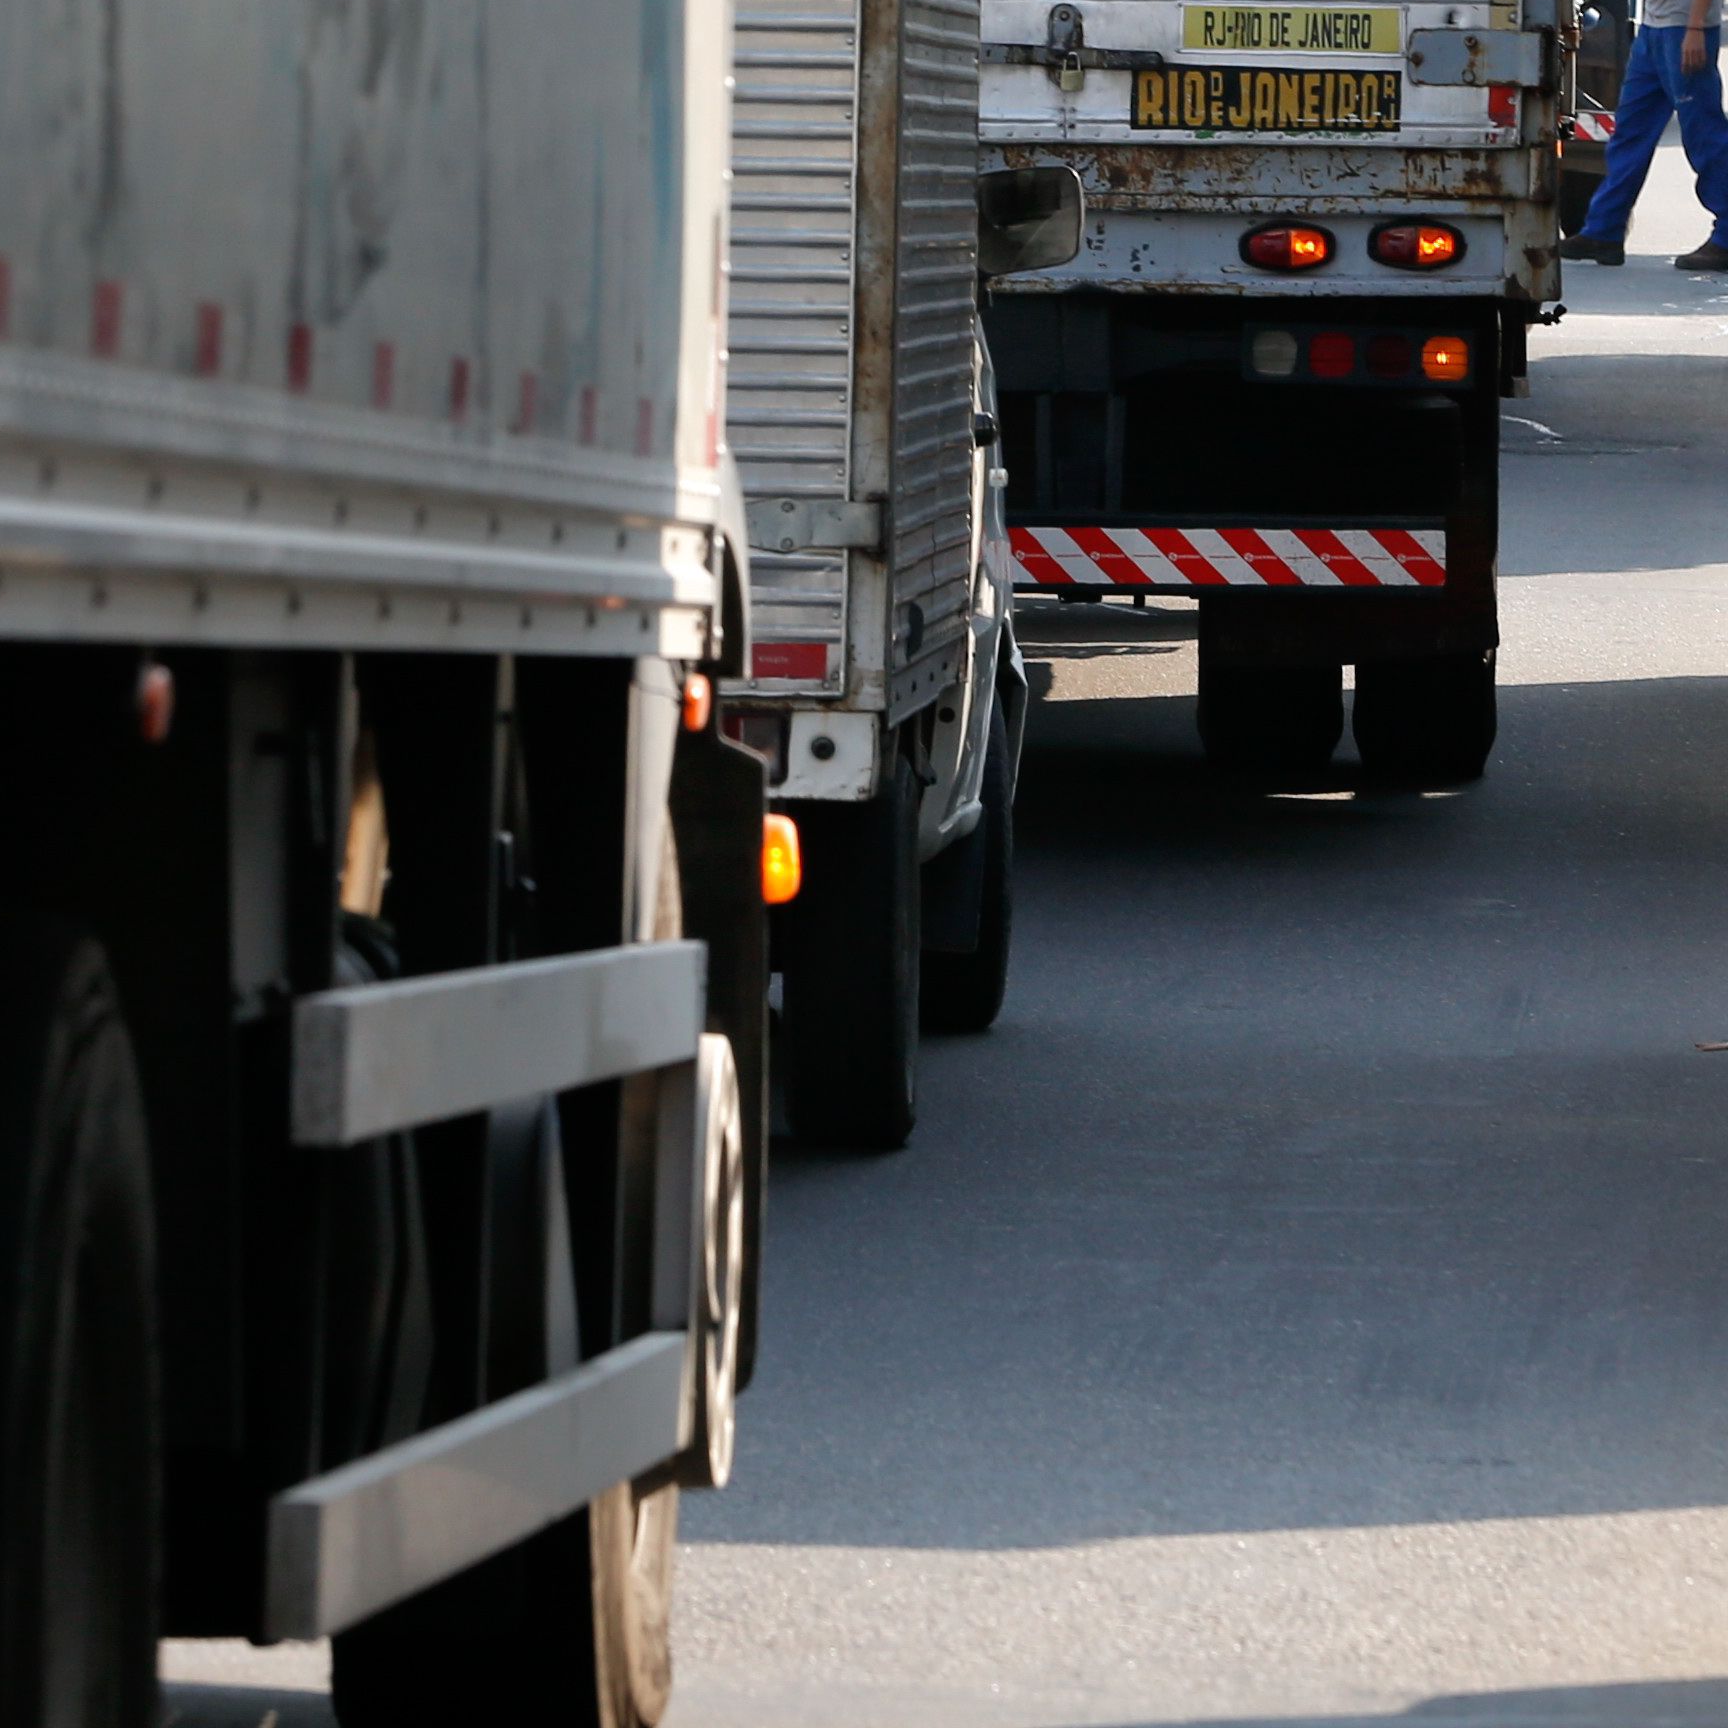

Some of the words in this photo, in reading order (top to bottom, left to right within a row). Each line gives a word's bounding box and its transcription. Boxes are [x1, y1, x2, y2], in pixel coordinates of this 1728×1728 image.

[1268, 12, 1292, 48] DE
[1297, 13, 1372, 49] JANEIRO
[1137, 70, 1204, 127] RIO
[1228, 71, 1379, 129] JANEIRO
